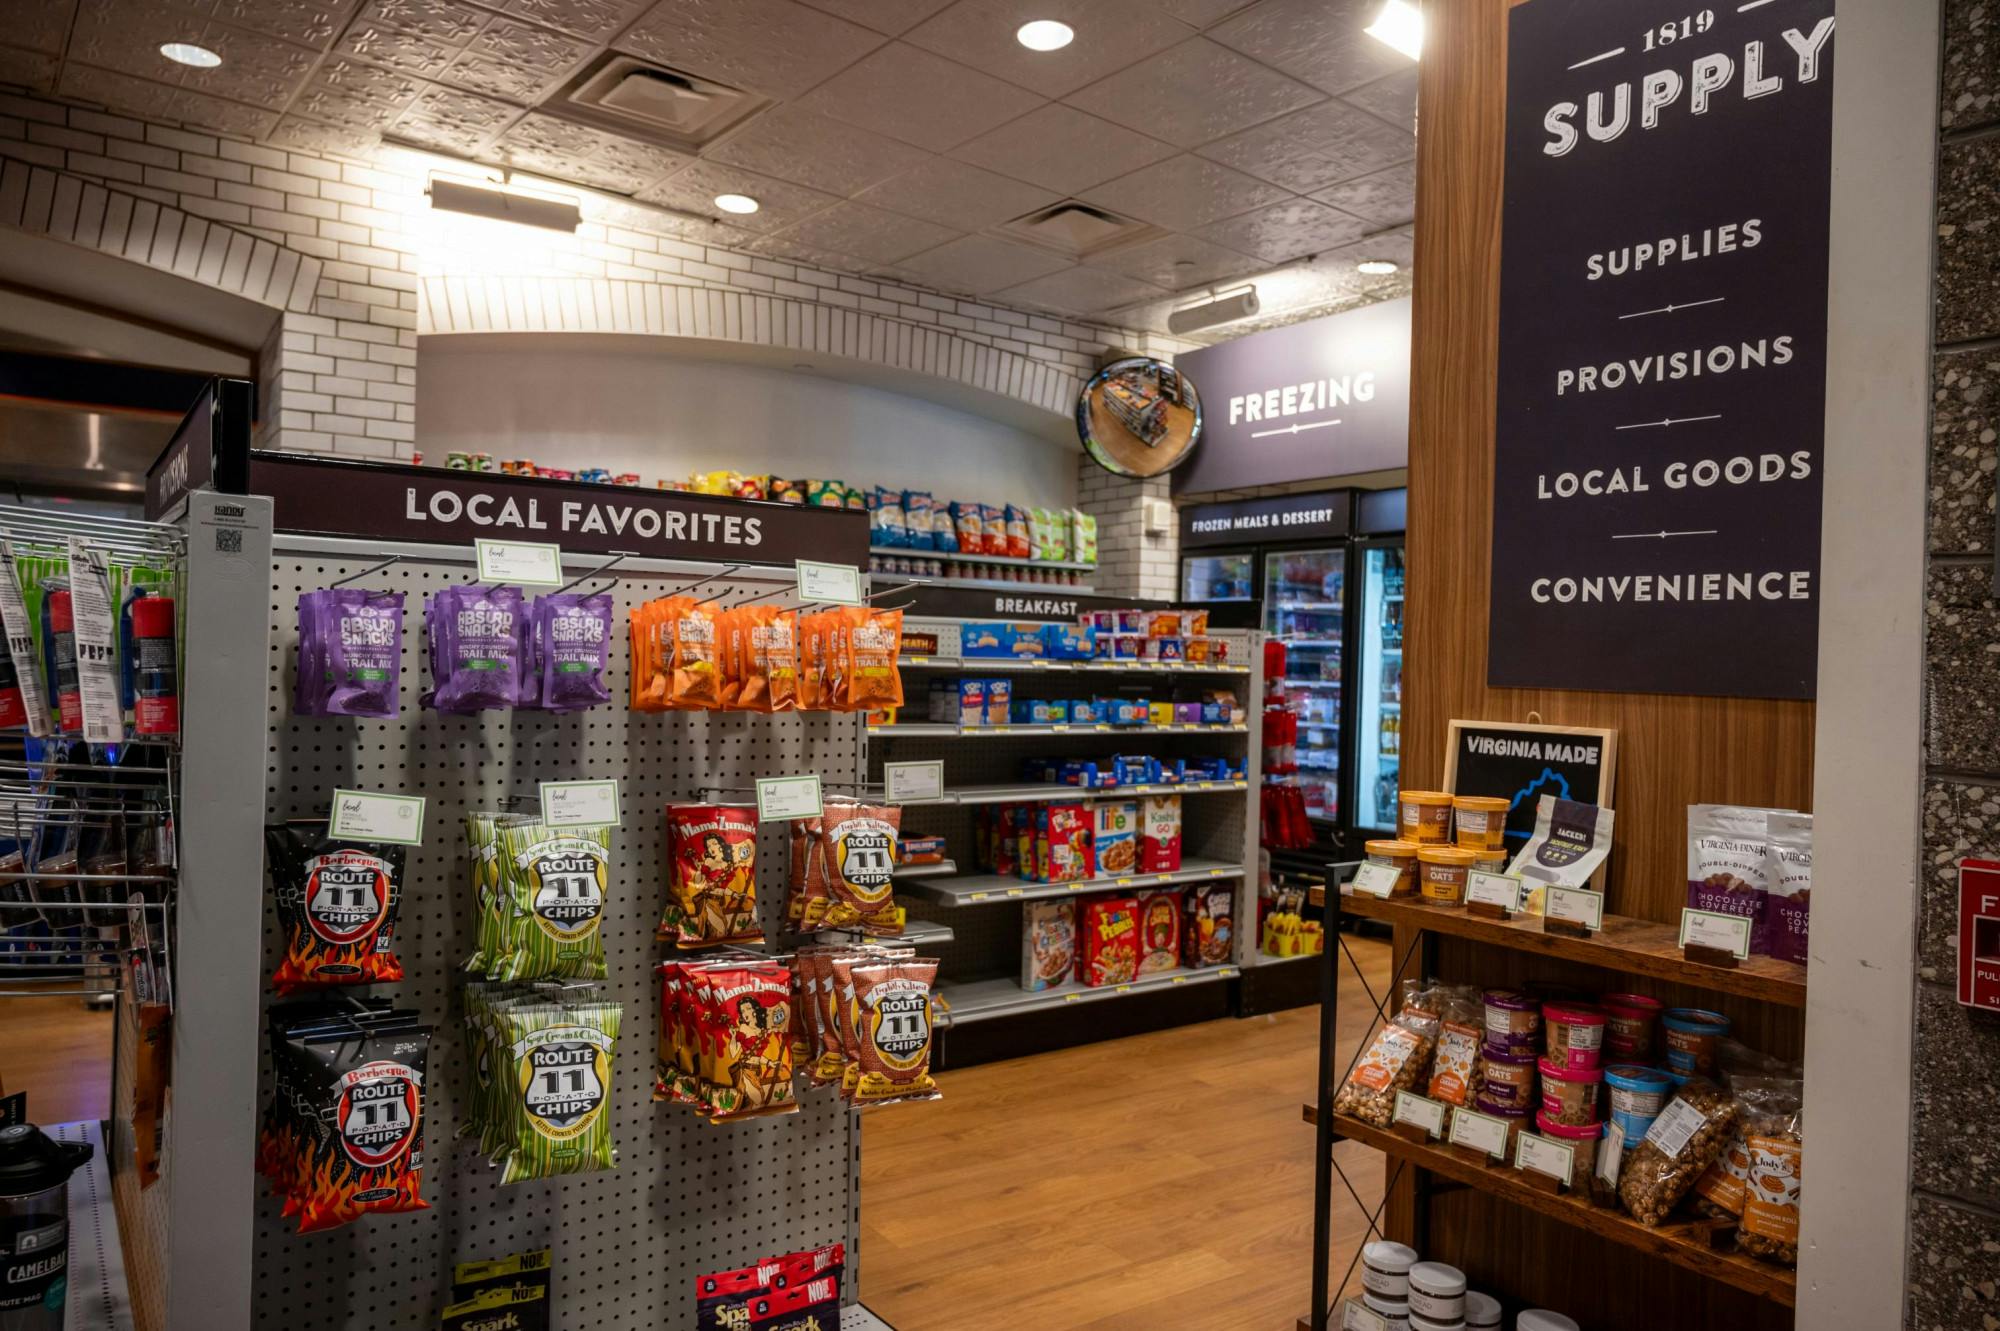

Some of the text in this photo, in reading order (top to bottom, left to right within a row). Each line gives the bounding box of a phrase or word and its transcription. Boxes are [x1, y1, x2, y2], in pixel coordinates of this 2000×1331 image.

[1642, 9, 1715, 53] 1819
[1543, 16, 1836, 157] SUPPLY
[1586, 218, 1762, 281] SUPPLIES
[1557, 335, 1794, 396] PROVISIONS
[1229, 371, 1376, 425] FREEZING
[1537, 450, 1812, 500] LOCAL GOODS
[405, 487, 763, 547] LOCAL FAVORITES
[1191, 508, 1334, 533] FROZEN MEALS & DESSERT
[1530, 571, 1811, 603] CONVENIENCE
[994, 597, 1078, 616] BREAKFAST
[340, 616, 396, 633] ABSURD
[457, 610, 513, 626] ABSURD
[551, 616, 605, 631] ABSURD
[341, 631, 395, 646] SNACKS
[457, 624, 511, 638] SNACKS
[551, 629, 604, 643] SNACKS
[459, 649, 509, 660] TRAIL MIX
[553, 653, 600, 663] TRAIL MIX
[343, 659, 377, 668] TRAIL
[1467, 735, 1600, 765] VIRGINIA MADE
[680, 821, 719, 840] Mama
[847, 837, 889, 847] ROUTE
[319, 854, 380, 868] Barbeque
[538, 858, 595, 874] ROUTE
[851, 851, 885, 868] 11
[320, 871, 375, 884] ROUTE
[851, 874, 891, 884] CHIPS
[1430, 872, 1454, 881] OATS
[546, 876, 590, 898] 11
[324, 887, 366, 907] 11
[1698, 892, 1763, 908] CHOCOLATE
[544, 905, 597, 919] CHIPS
[1700, 901, 1754, 915] COVERED
[318, 912, 371, 923] CHIPS
[712, 983, 753, 1006] Mama
[881, 998, 925, 1012] ROUTE
[886, 1014, 920, 1035] 11
[883, 1040, 924, 1052] CHIPS
[534, 1048, 593, 1066] ROUTE
[346, 1066, 409, 1084] Barbeque
[538, 1068, 585, 1094] 11
[1488, 1067, 1512, 1081] OATS
[352, 1083, 406, 1101] ROUTE
[356, 1100, 398, 1126] 11
[536, 1100, 593, 1116] CHIPS
[353, 1129, 404, 1147] CHIPS
[714, 1304, 751, 1329] Spa
